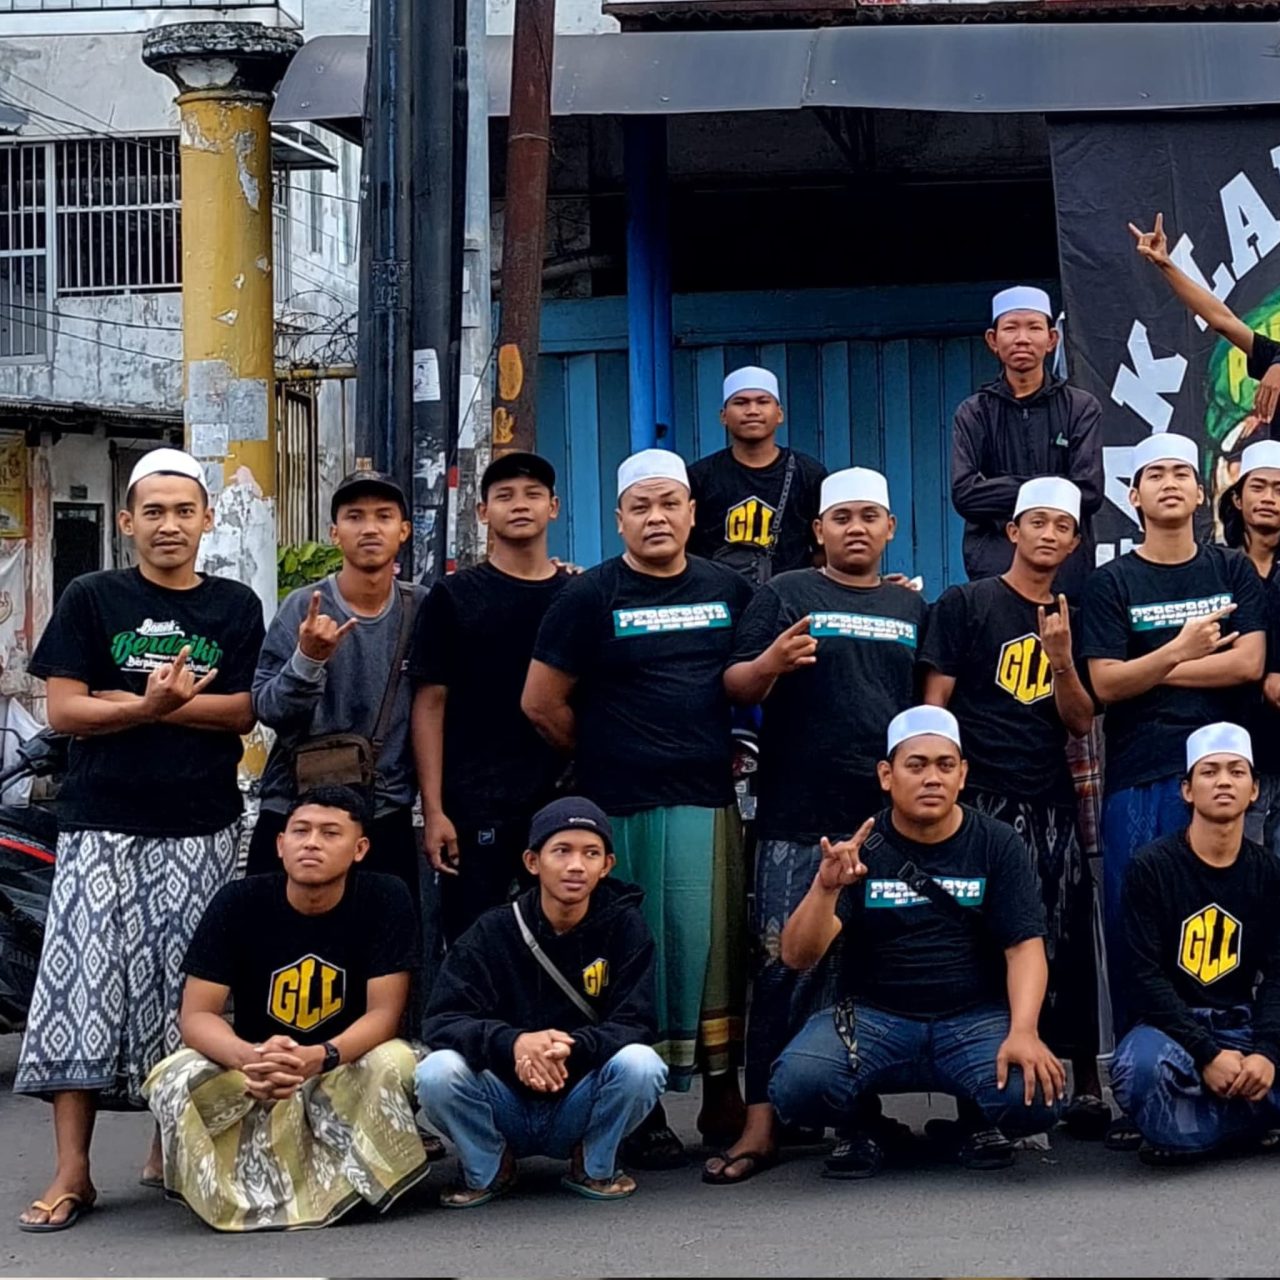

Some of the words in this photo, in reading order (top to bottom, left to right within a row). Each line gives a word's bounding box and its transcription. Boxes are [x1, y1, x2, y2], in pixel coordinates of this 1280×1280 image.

[1001, 637, 1051, 701] GLL
[1182, 907, 1238, 983] GLL
[272, 958, 342, 1029] GLL
